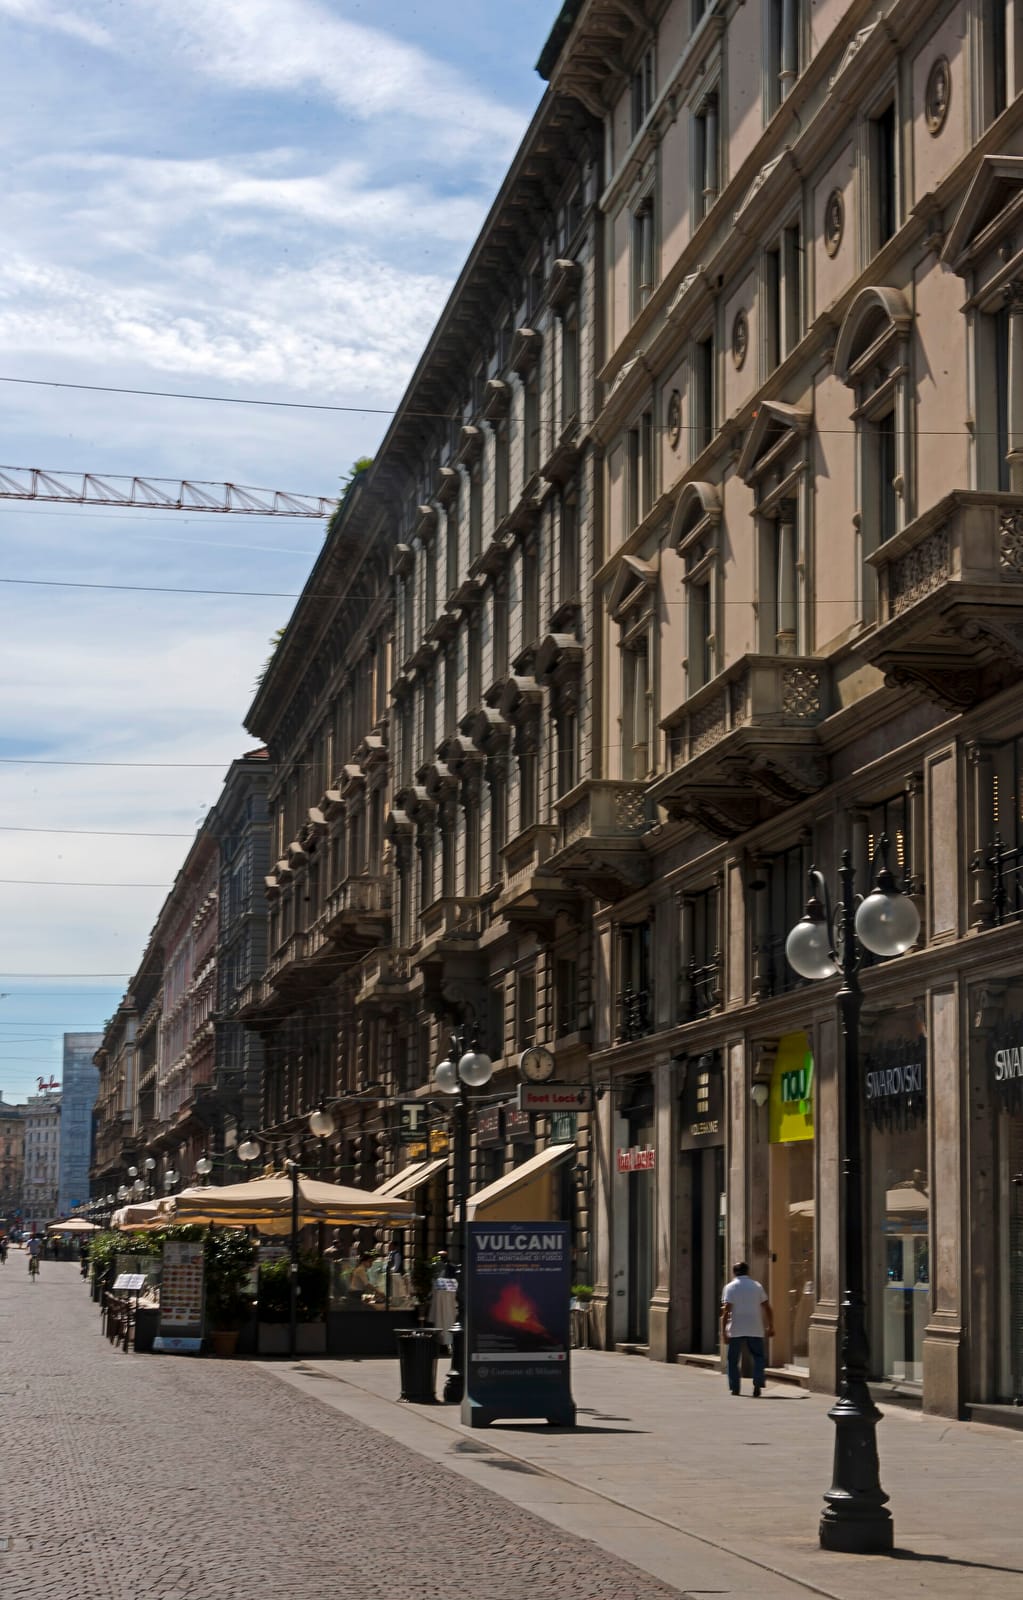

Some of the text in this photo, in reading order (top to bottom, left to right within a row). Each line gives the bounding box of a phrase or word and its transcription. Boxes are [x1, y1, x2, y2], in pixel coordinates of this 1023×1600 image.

[865, 1063, 922, 1099] SWAROVSKI
[527, 1093, 549, 1103] Foot
[475, 1234, 563, 1250] VULCANI
